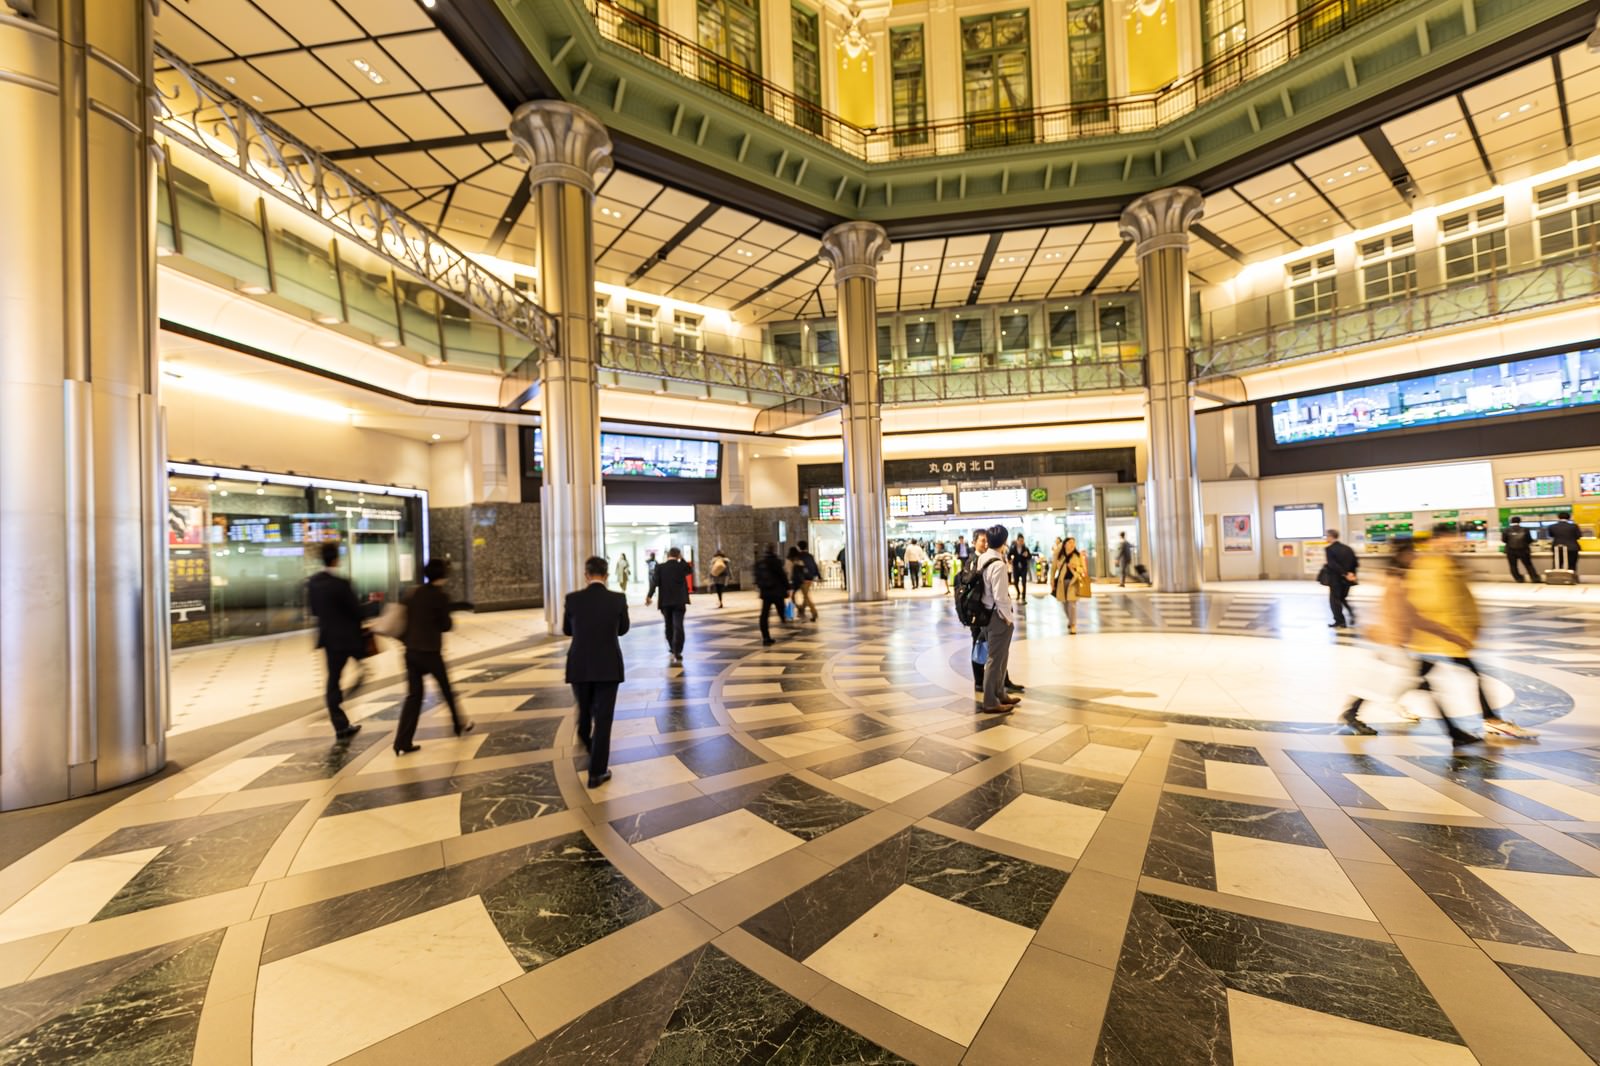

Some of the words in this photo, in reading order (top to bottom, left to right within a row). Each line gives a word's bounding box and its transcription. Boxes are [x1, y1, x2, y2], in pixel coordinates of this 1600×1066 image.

[929, 460, 995, 473] 丸の内北口
